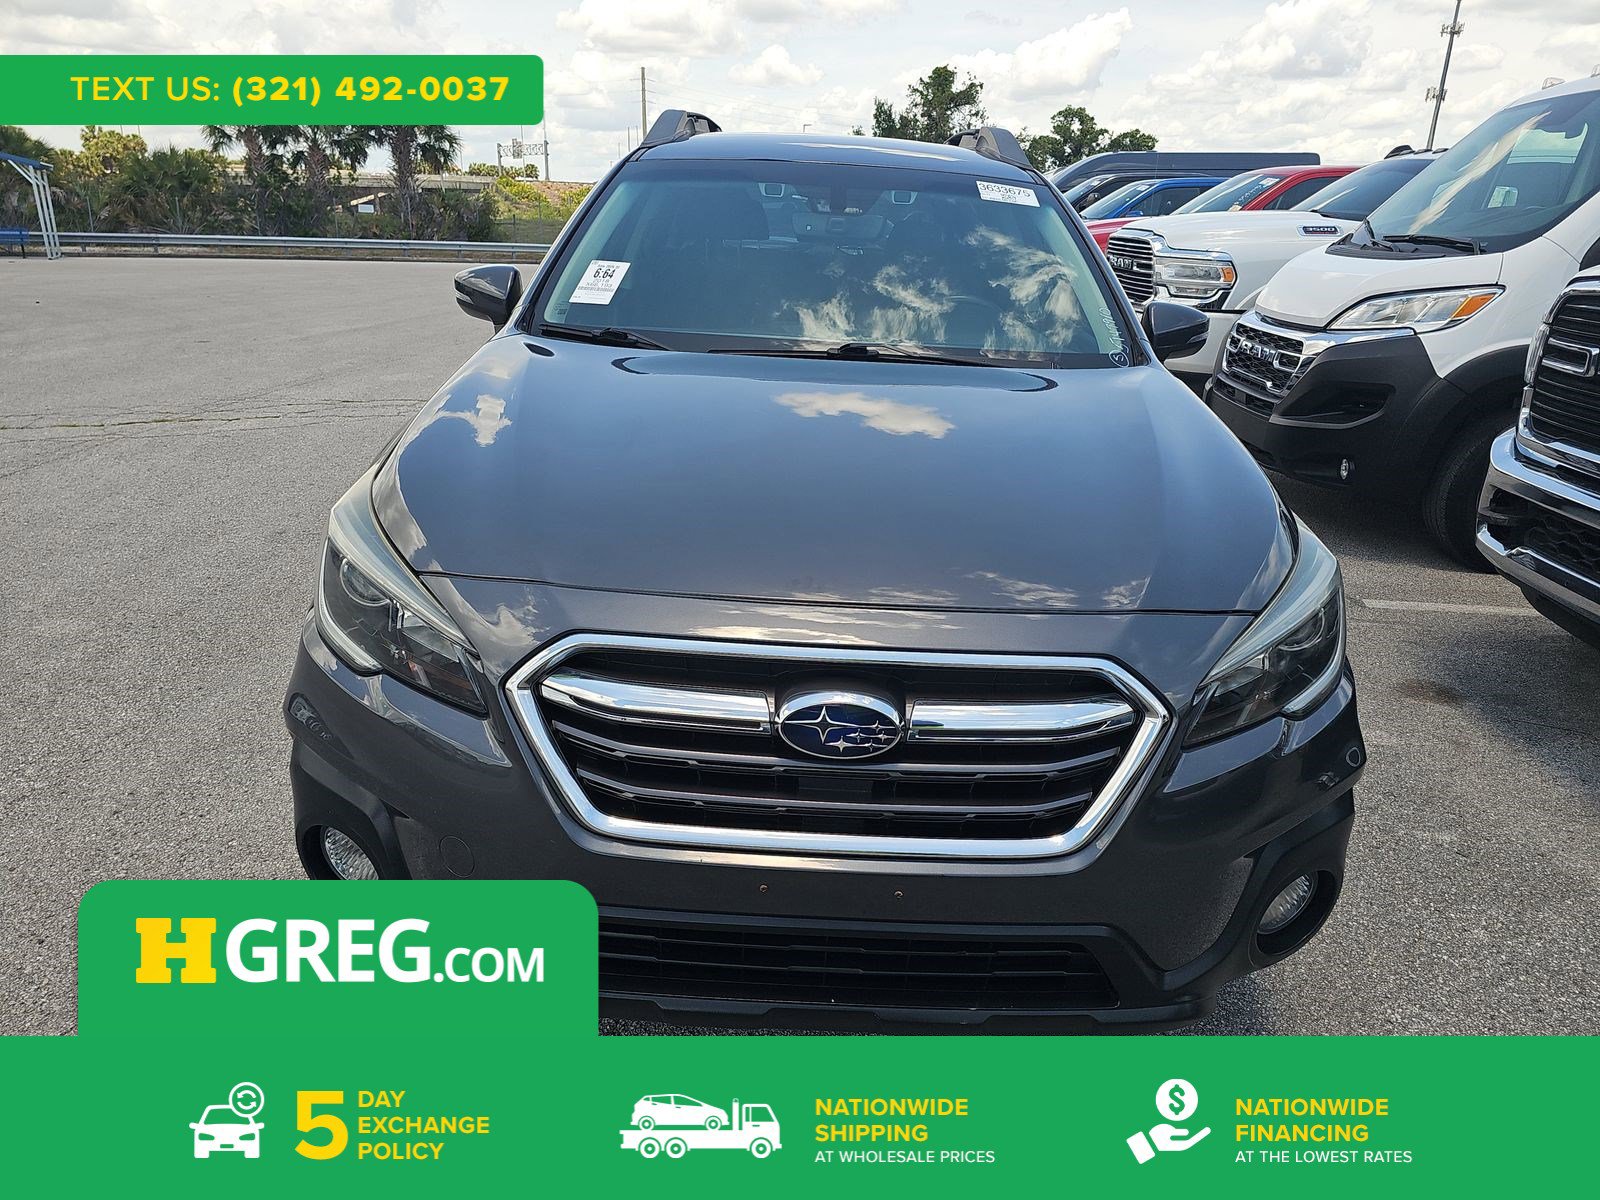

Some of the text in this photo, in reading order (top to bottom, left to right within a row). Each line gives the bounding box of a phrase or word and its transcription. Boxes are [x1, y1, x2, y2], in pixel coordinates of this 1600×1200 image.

[978, 182, 1031, 198] 3633675
[1107, 254, 1132, 269] RAM
[593, 267, 616, 279] 6:64
[1241, 340, 1277, 362] RAM
